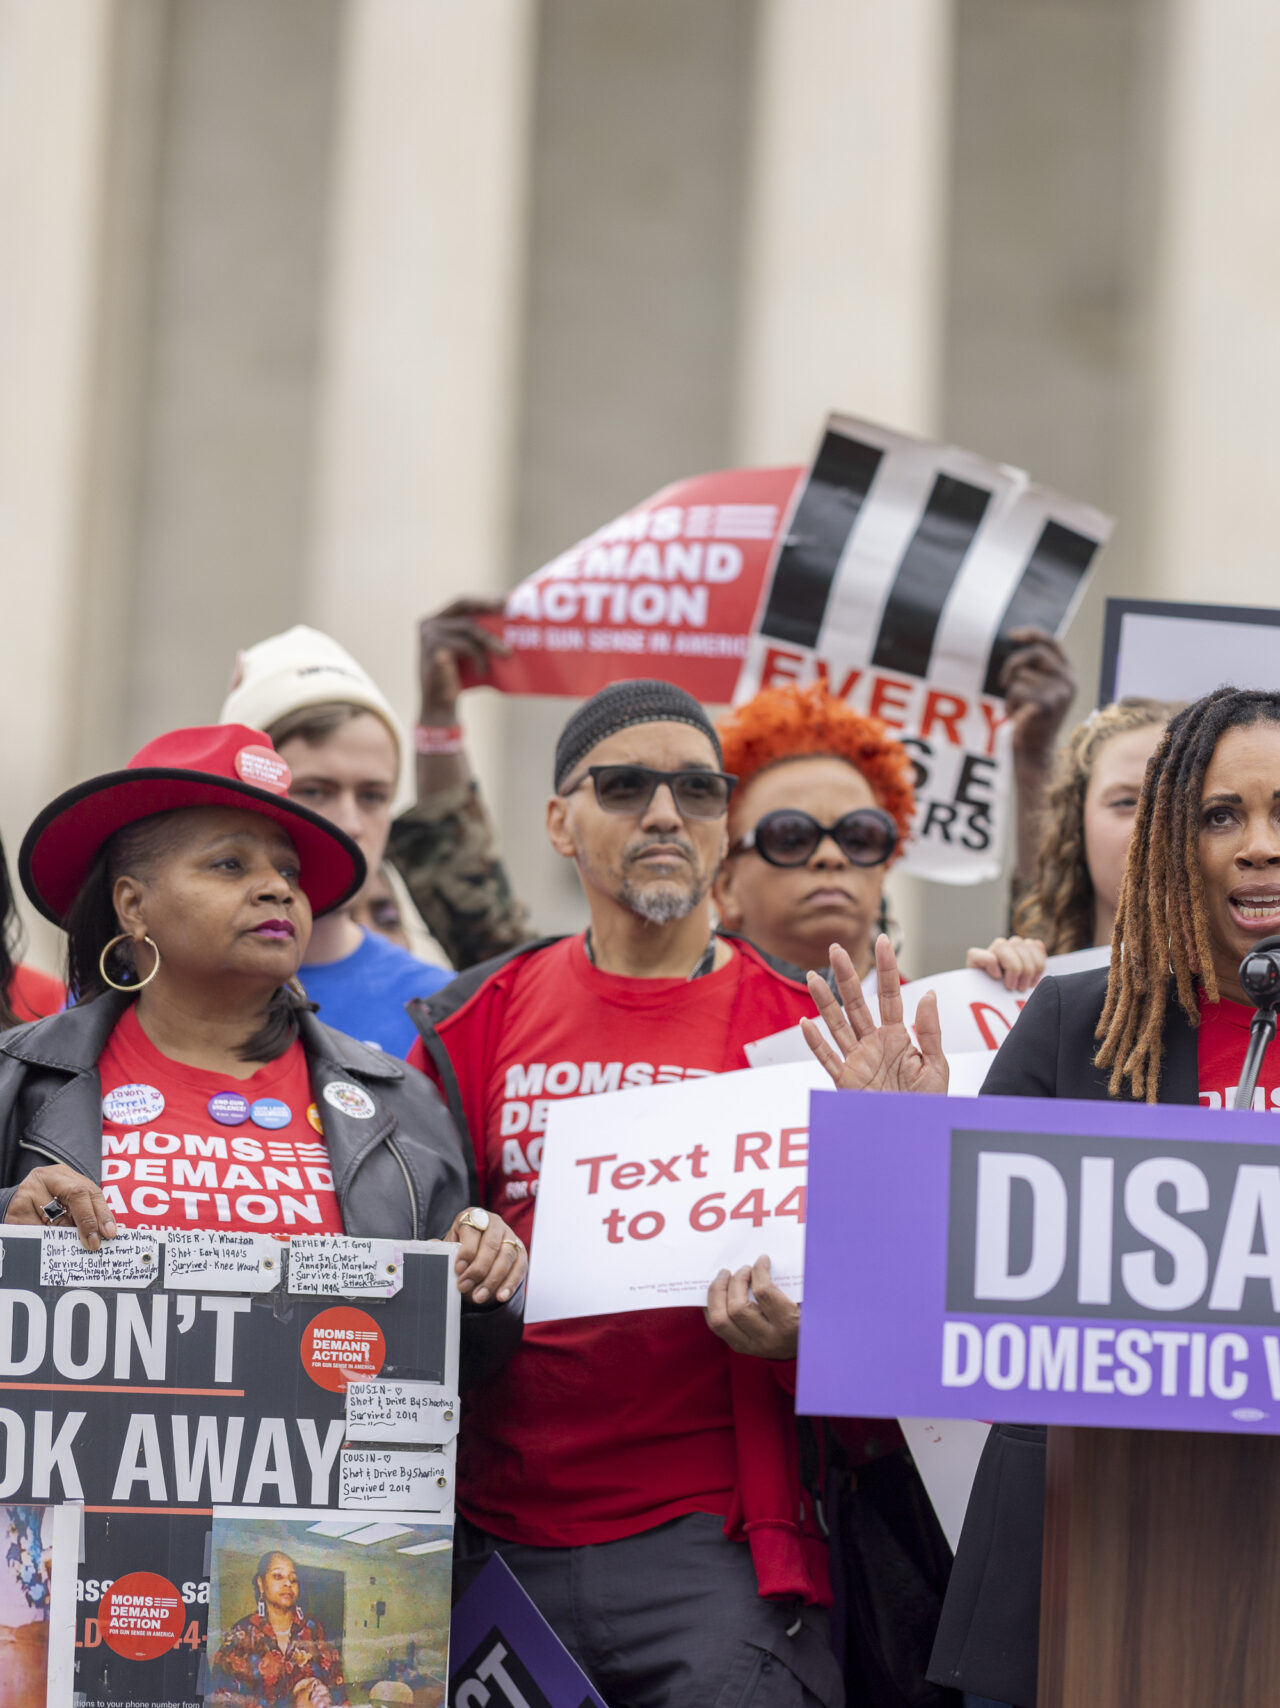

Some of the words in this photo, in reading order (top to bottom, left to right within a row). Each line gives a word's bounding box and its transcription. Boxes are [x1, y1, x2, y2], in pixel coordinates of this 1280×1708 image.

[505, 583, 709, 628] ACTION
[544, 627, 585, 651] GUN
[590, 627, 644, 653] SENSE
[649, 630, 670, 655] IN
[504, 1061, 655, 1098] MOMS
[102, 1131, 265, 1162] MOMS
[101, 1159, 335, 1191] DEMAND
[575, 1144, 709, 1195] Text
[104, 1185, 322, 1224] ACTION
[602, 1208, 666, 1244] to
[44, 1230, 55, 1240] MY
[295, 1252, 314, 1262] Shot
[333, 1253, 359, 1262] Chest
[215, 1260, 234, 1269] Knee
[237, 1260, 259, 1273] Wound
[297, 1283, 318, 1294] Early
[0, 1290, 251, 1383] DON'T
[313, 1329, 354, 1340] MOMS
[313, 1340, 370, 1351] DEMAND
[312, 1351, 362, 1362] ACTION
[941, 1321, 1249, 1399] DOMESTIC
[350, 1397, 374, 1406] Shot
[386, 1397, 407, 1405] Drive
[396, 1411, 418, 1422] 2019
[112, 1413, 347, 1505] AWAY
[343, 1468, 363, 1480] Shot
[374, 1468, 397, 1478] Drive
[343, 1482, 385, 1495] Survived
[390, 1484, 411, 1493] 2019
[111, 1595, 153, 1606] MOMS
[110, 1606, 169, 1618] DEMAND
[109, 1617, 161, 1629] ACTION
